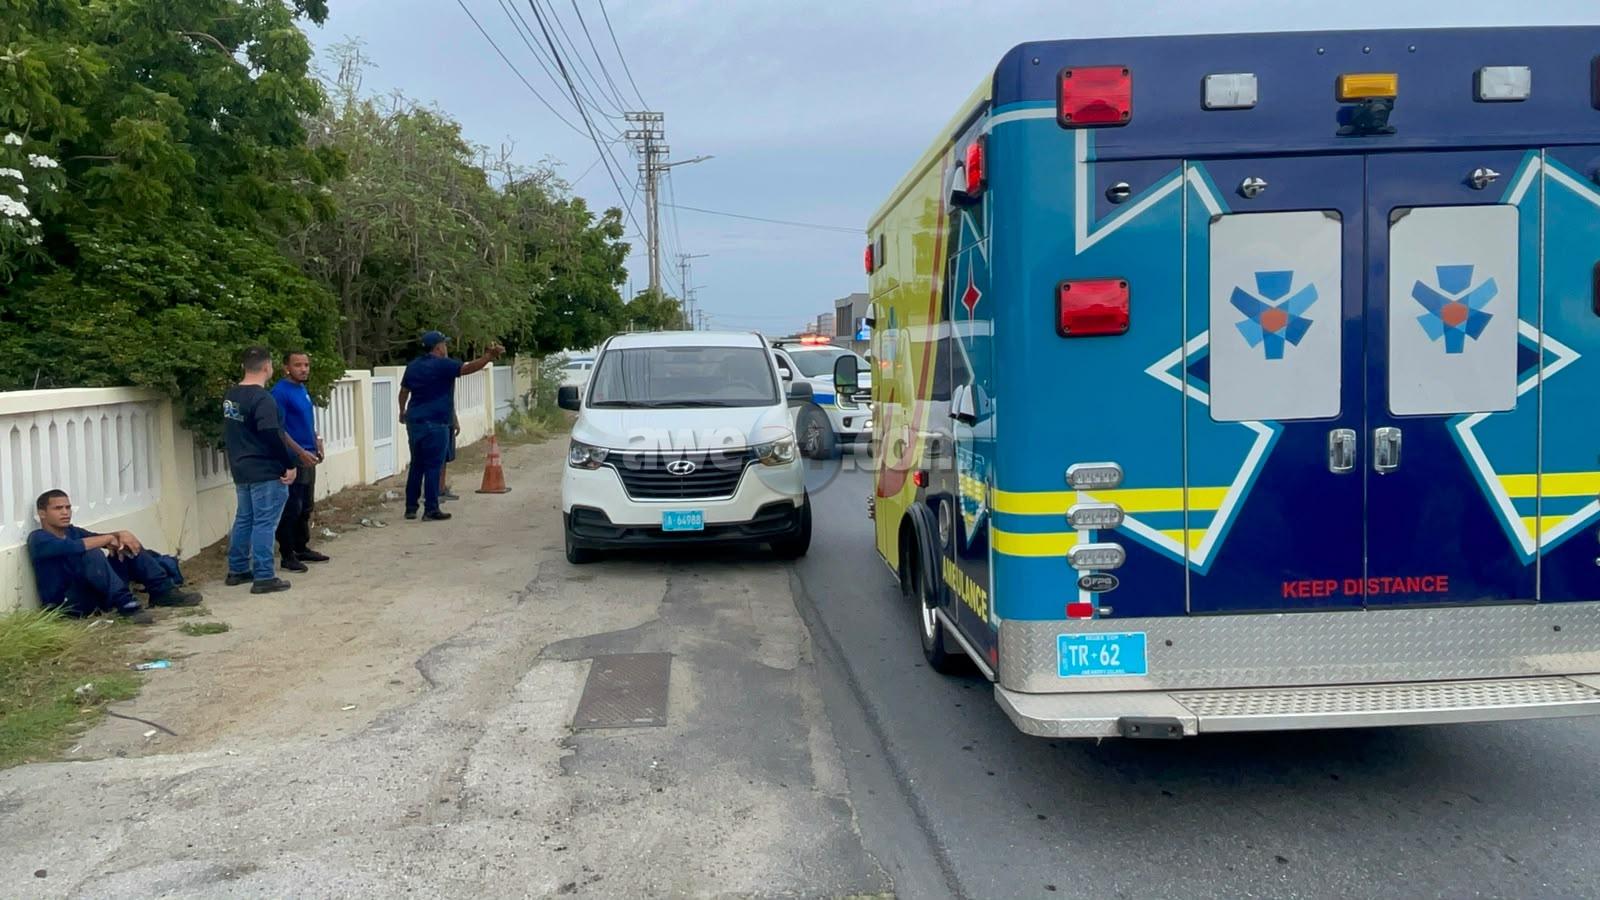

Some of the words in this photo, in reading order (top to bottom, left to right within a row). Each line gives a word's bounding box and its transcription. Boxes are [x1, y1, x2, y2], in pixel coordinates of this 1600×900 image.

[943, 555, 988, 624] AMBULANCE
[1282, 580, 1338, 598] KEEP
[1342, 575, 1449, 596] DISTANCE
